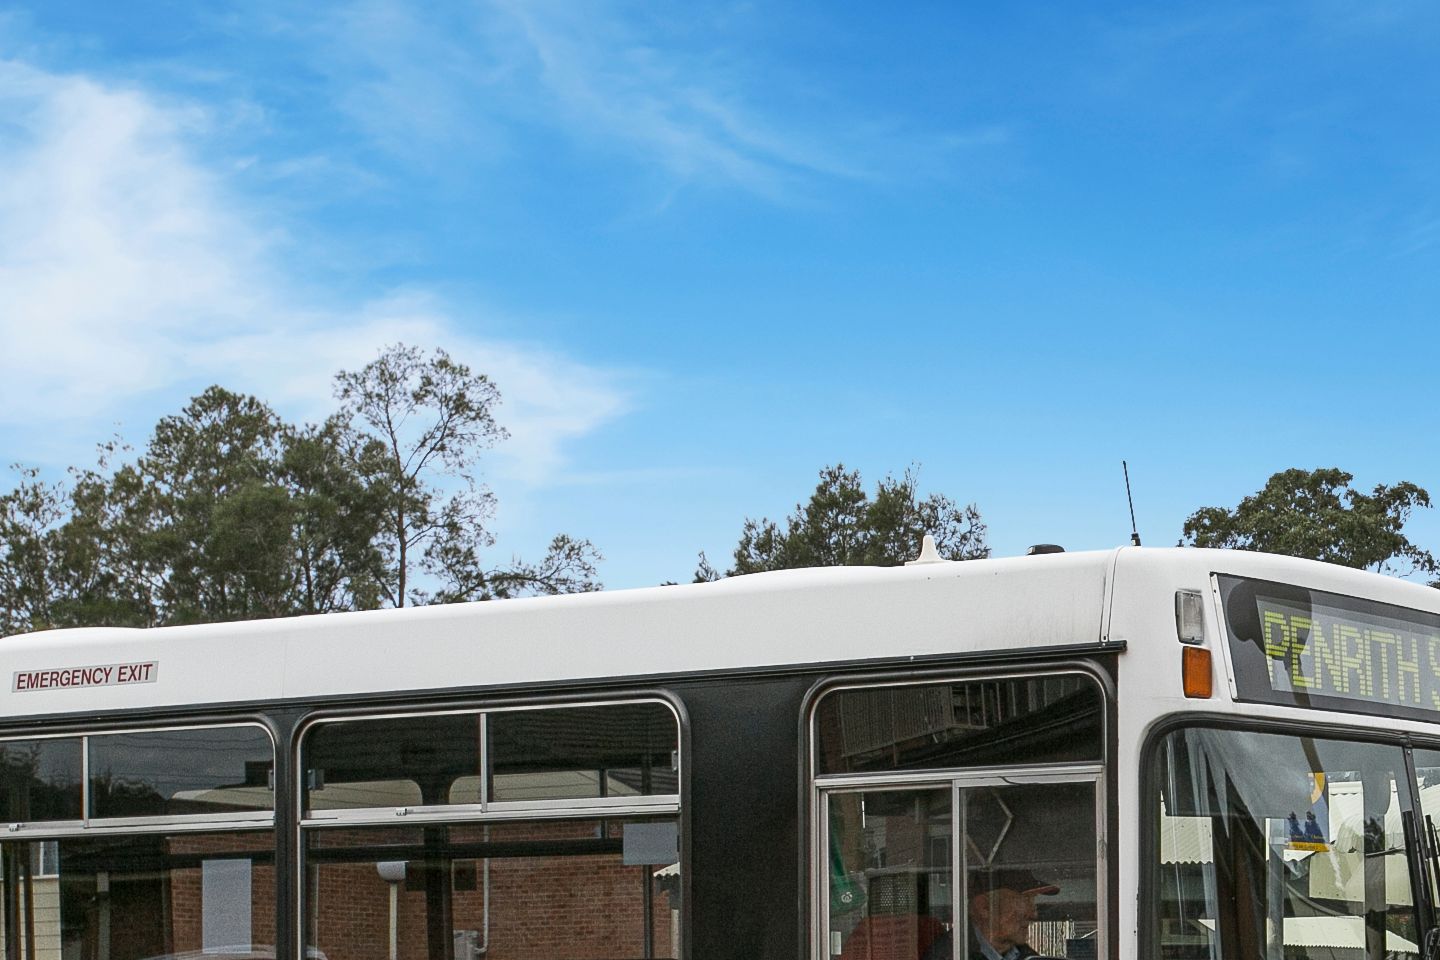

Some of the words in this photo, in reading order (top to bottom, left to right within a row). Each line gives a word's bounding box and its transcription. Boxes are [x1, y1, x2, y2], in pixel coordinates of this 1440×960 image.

[16, 666, 113, 690] EMERGENCY
[117, 663, 153, 683] EXIT
[1264, 610, 1421, 703] PENRITH
